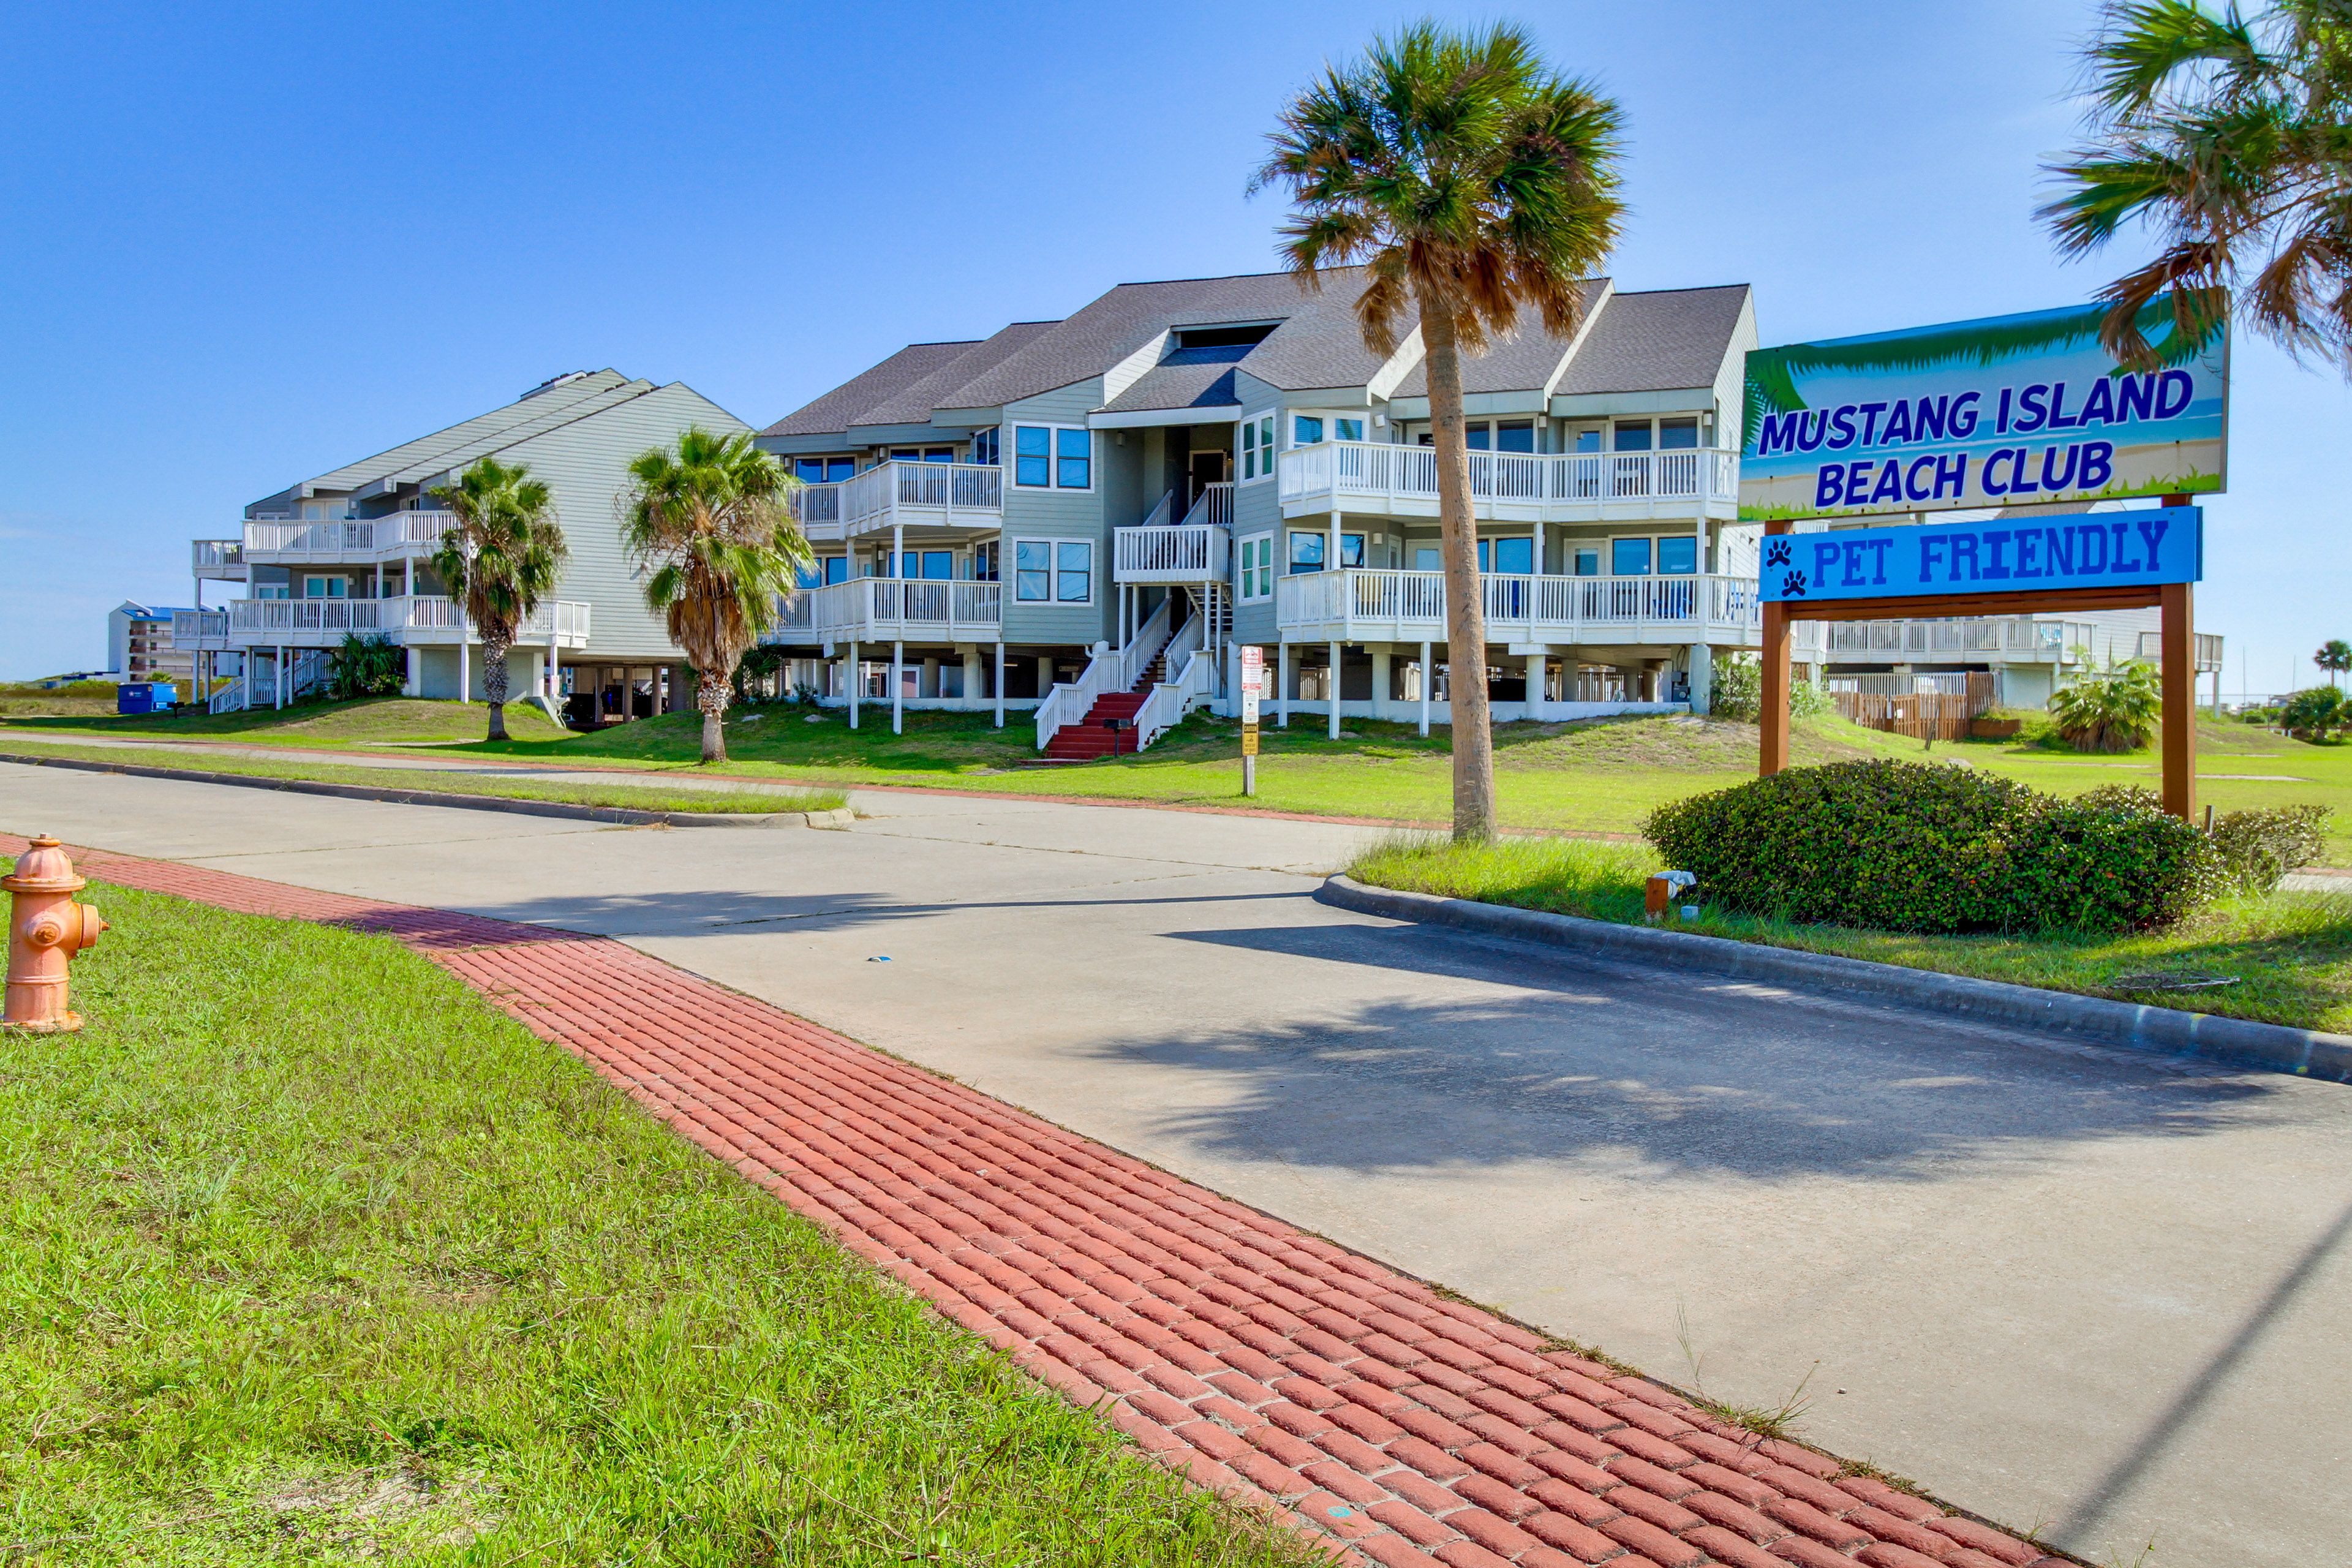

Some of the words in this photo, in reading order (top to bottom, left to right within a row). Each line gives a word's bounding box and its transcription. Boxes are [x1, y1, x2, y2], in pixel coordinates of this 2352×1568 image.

[1758, 392, 1981, 455] MUSTANG
[1996, 370, 2193, 433] ISLAND
[1815, 454, 1967, 507] BEACH
[1981, 442, 2113, 496] CLUB
[1812, 538, 1894, 588] PET
[1918, 519, 2169, 583] FRIENDLY
